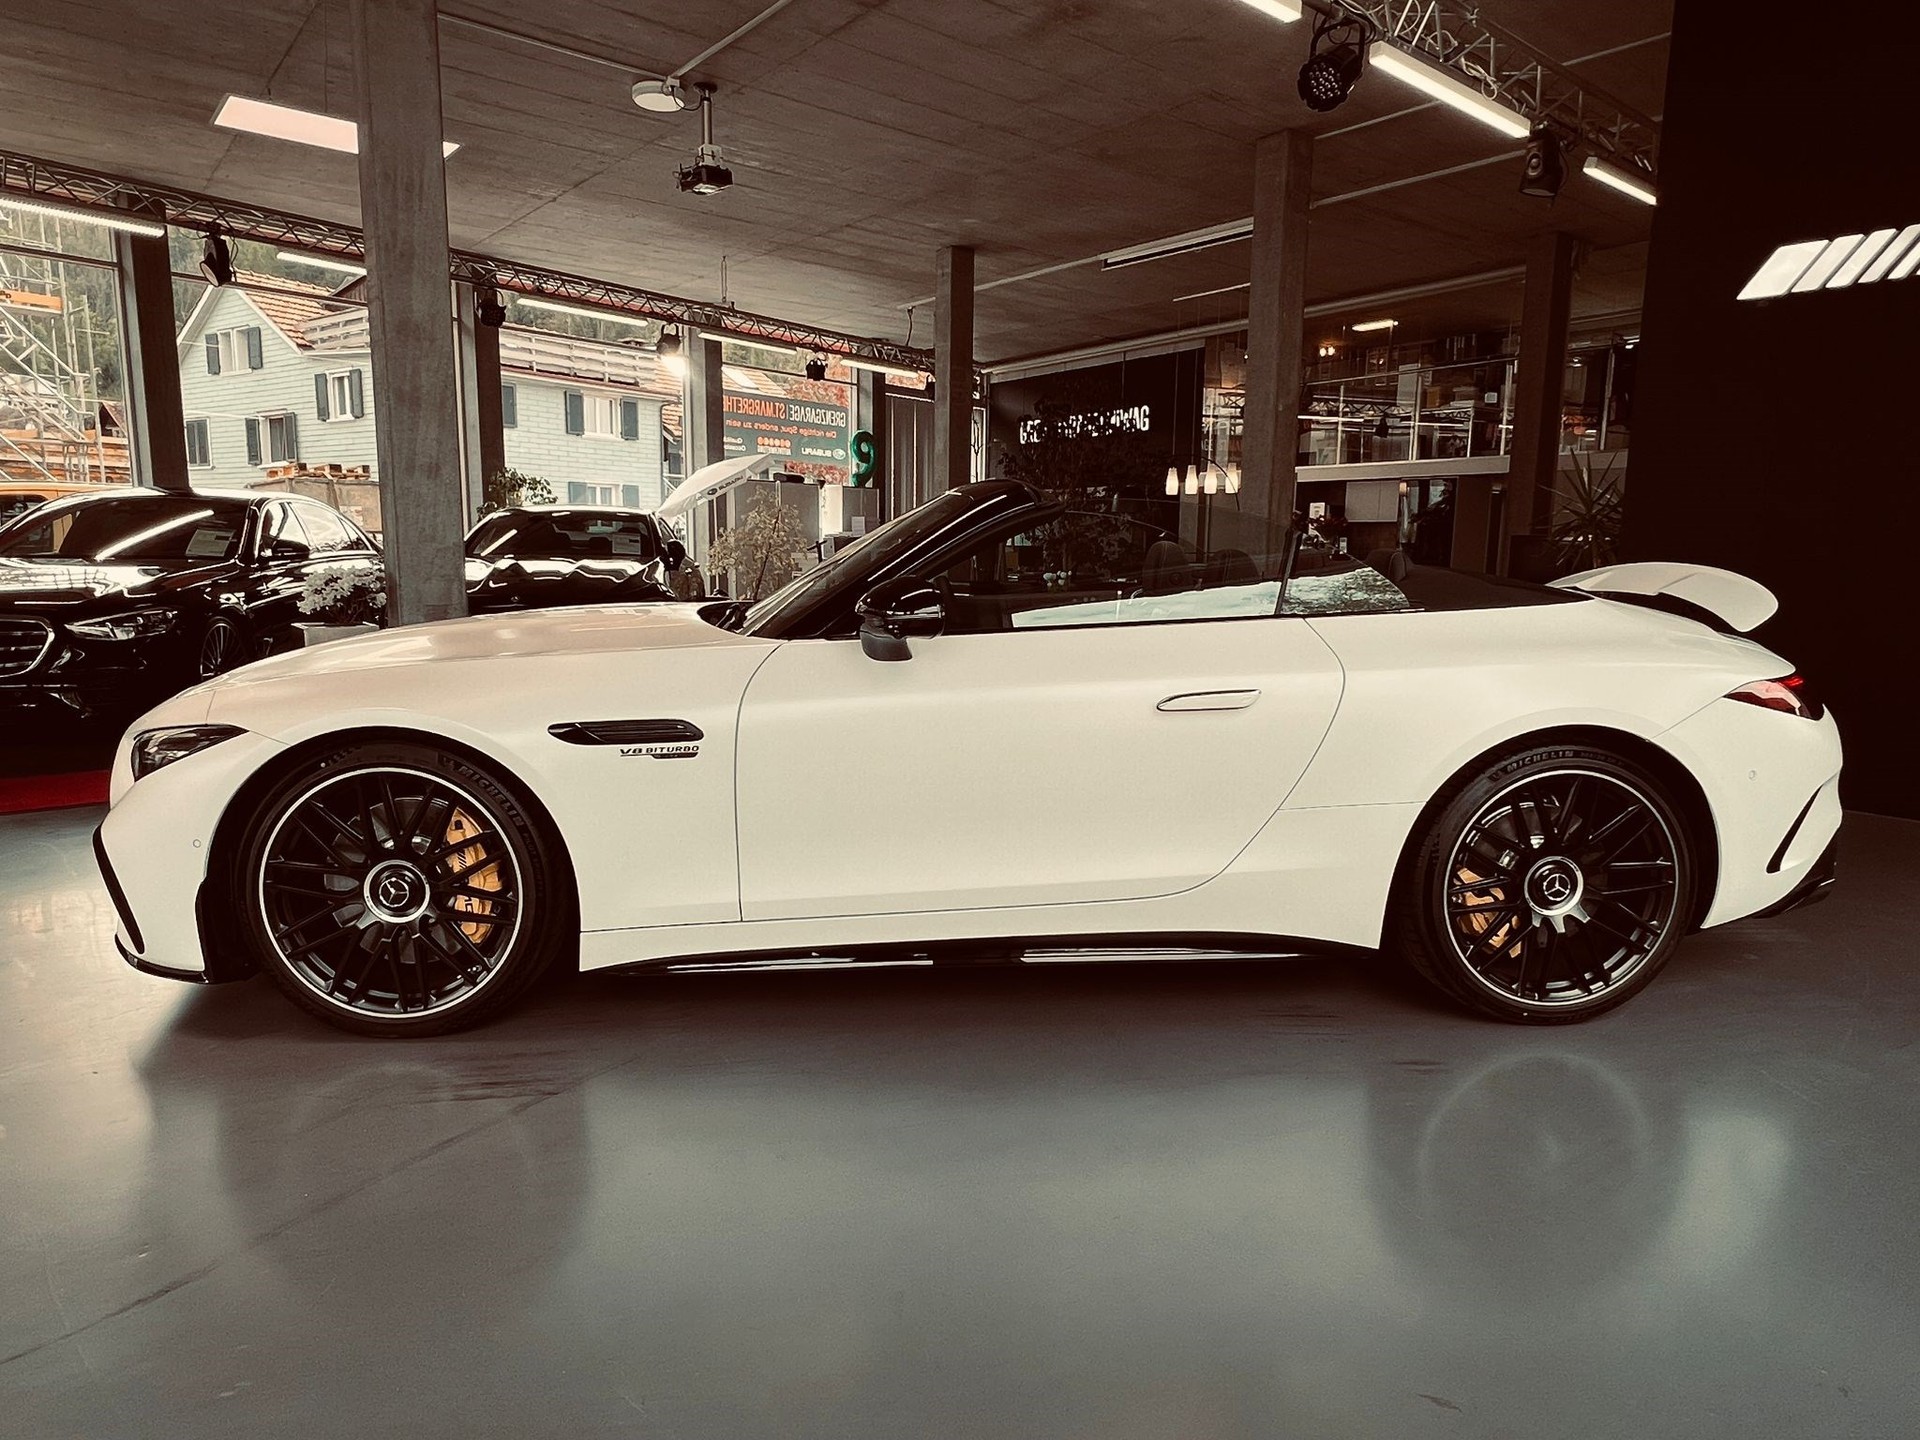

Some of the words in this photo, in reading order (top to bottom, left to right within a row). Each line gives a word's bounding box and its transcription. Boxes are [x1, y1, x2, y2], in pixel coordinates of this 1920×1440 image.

[619, 748, 643, 756] V8
[645, 745, 700, 753] BITURBO
[1506, 750, 1574, 772] MICHELIN
[457, 764, 527, 828] MICHELIN
